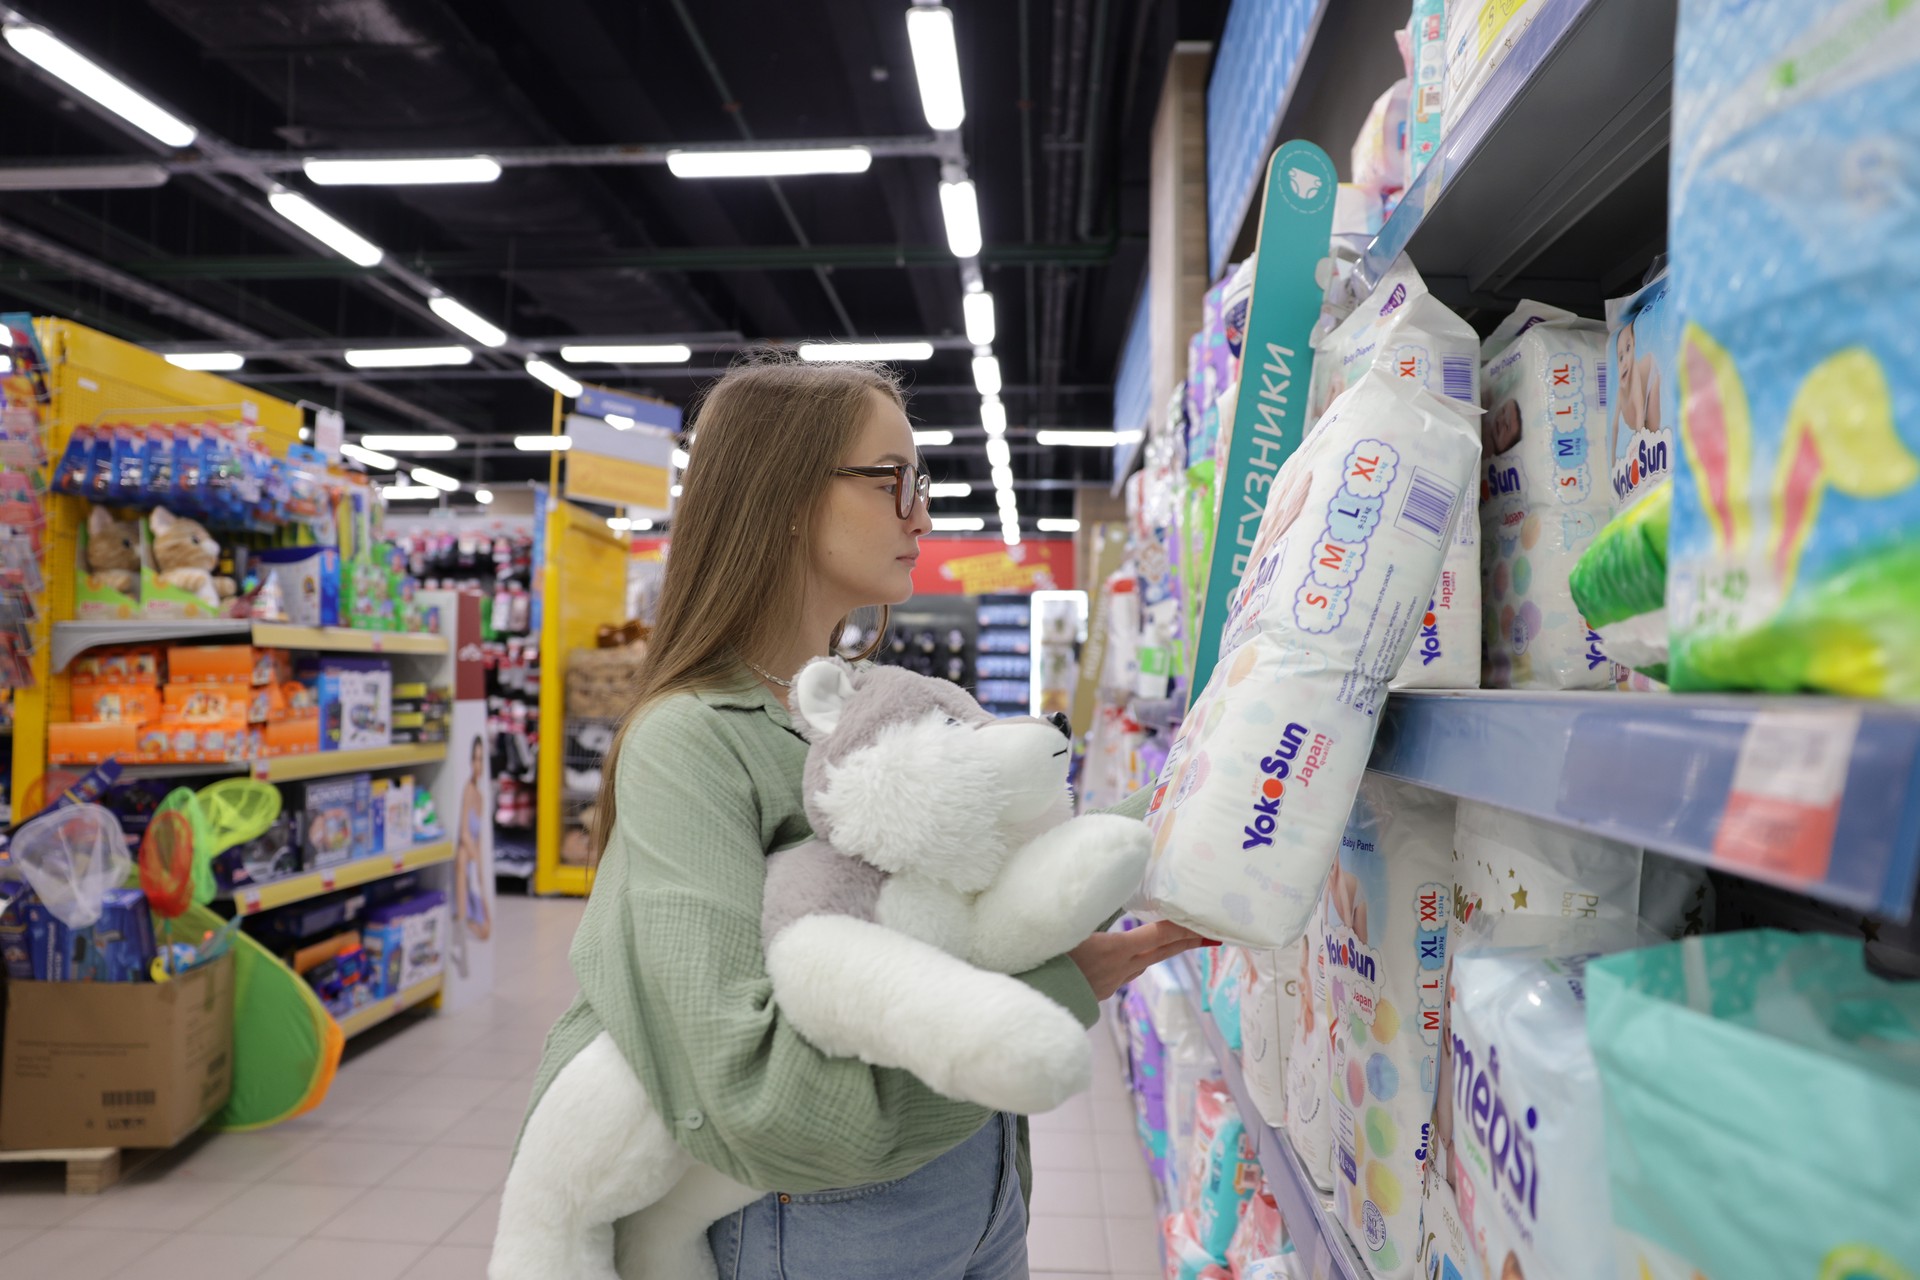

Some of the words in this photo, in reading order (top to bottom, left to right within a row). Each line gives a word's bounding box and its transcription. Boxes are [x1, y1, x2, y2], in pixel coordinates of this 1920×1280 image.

[1400, 356, 1416, 377] XL
[1553, 363, 1570, 386] XL
[1556, 405, 1571, 416] L
[1557, 438, 1574, 457] M
[1351, 455, 1380, 482] XL
[1222, 342, 1295, 640] ДГУЗНИКИ
[1560, 476, 1577, 487] S
[1337, 507, 1361, 519] L
[1357, 514, 1368, 530] 9-13
[1363, 506, 1372, 515] kg
[1319, 543, 1346, 570] M
[1305, 592, 1328, 609] S
[1439, 571, 1453, 610] Japan
[1420, 597, 1442, 667] Yoko
[1295, 732, 1327, 788] Japan
[1319, 737, 1335, 766] quality
[1242, 722, 1309, 850] YokoSun
[1342, 836, 1356, 851] Baby
[1356, 839, 1375, 853] Pants
[1420, 890, 1437, 922] XXL
[1438, 895, 1445, 904] kg
[1421, 935, 1438, 959] XL
[1438, 936, 1445, 944] kg
[1325, 933, 1376, 982] YokoSun
[1422, 979, 1439, 989] L
[1352, 988, 1373, 1009] Japan
[1423, 1011, 1440, 1030] M
